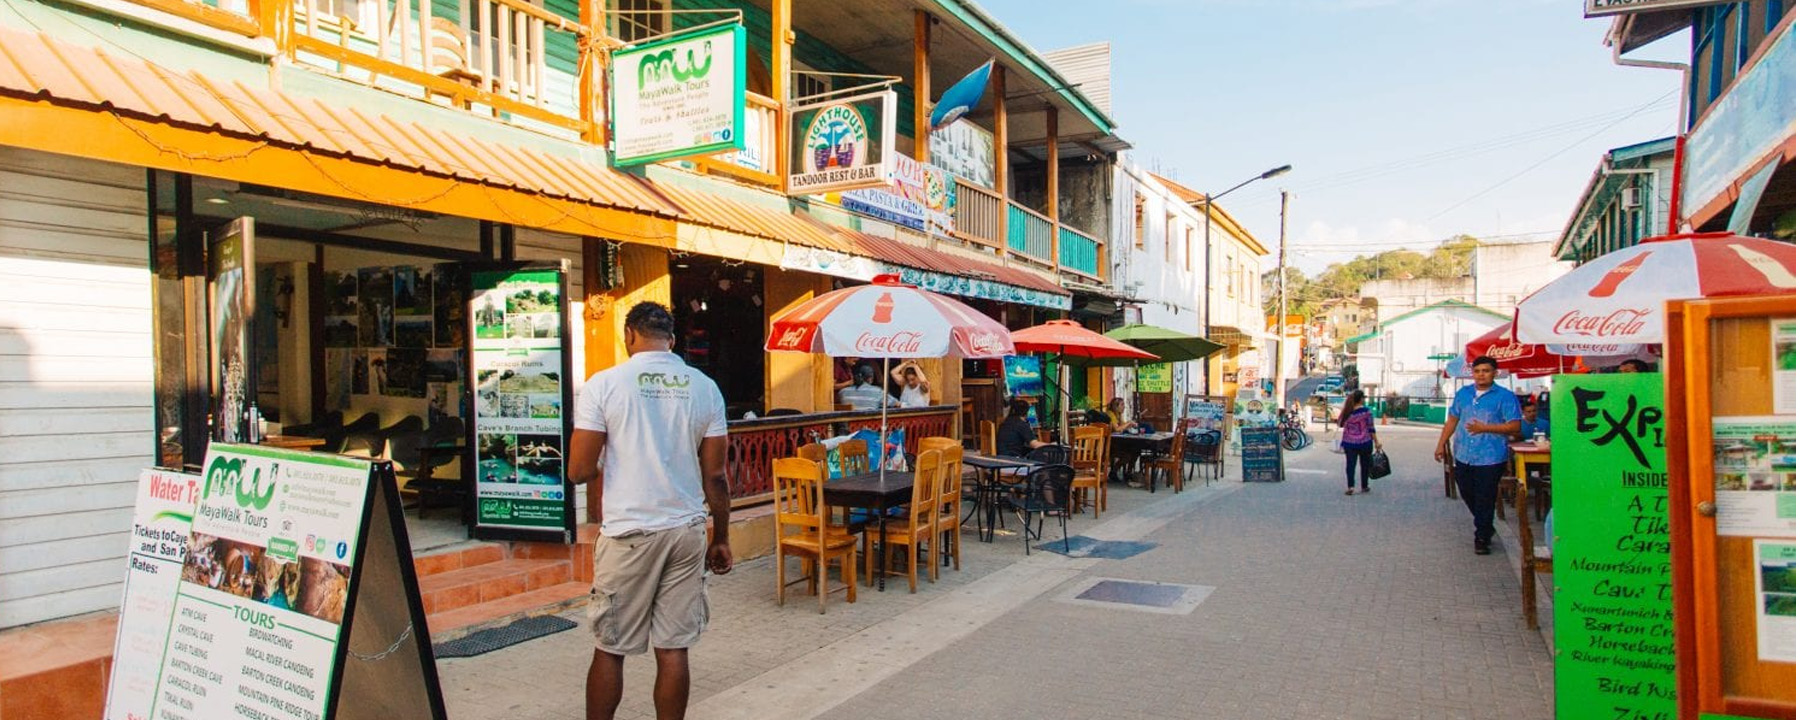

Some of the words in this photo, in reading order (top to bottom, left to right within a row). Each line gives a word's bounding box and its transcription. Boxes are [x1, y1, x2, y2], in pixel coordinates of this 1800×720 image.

[686, 80, 710, 91] Tours
[807, 107, 865, 149] LIGHTHOUSE
[793, 172, 828, 186] TANDOOR
[829, 170, 849, 183] REST
[850, 169, 857, 180] &
[858, 167, 875, 179] BAR
[1553, 308, 1653, 336] Coca-Cola
[855, 331, 924, 353] Coca-Cola
[1486, 342, 1523, 359] Coca-Cola
[150, 474, 184, 501] Water
[1622, 470, 1668, 487] INSIDE
[199, 503, 241, 522] MayaWalk
[244, 510, 268, 528] Tours
[134, 524, 160, 539] Tickets
[141, 541, 157, 553] and
[160, 543, 177, 556] San
[132, 557, 158, 574] Rates:
[1570, 557, 1652, 574] Mountain
[233, 605, 276, 629] TOURS
[1583, 617, 1645, 633] Barton
[200, 631, 214, 643] CAVE
[249, 627, 293, 649] BIRDWATCHING
[246, 646, 265, 661] MACAL
[266, 653, 283, 666] RIVER
[284, 659, 314, 678] CANOEING
[1571, 650, 1609, 663] River
[192, 665, 208, 677] CREEK
[209, 671, 223, 684] CAVE
[241, 665, 265, 680] BARTON
[265, 674, 283, 688] CREEK
[284, 680, 315, 700] CANOEING
[1597, 677, 1641, 696] Bird
[239, 684, 269, 704] MOUNTAIN
[270, 697, 284, 710] PINE
[285, 702, 303, 717] RIDGE
